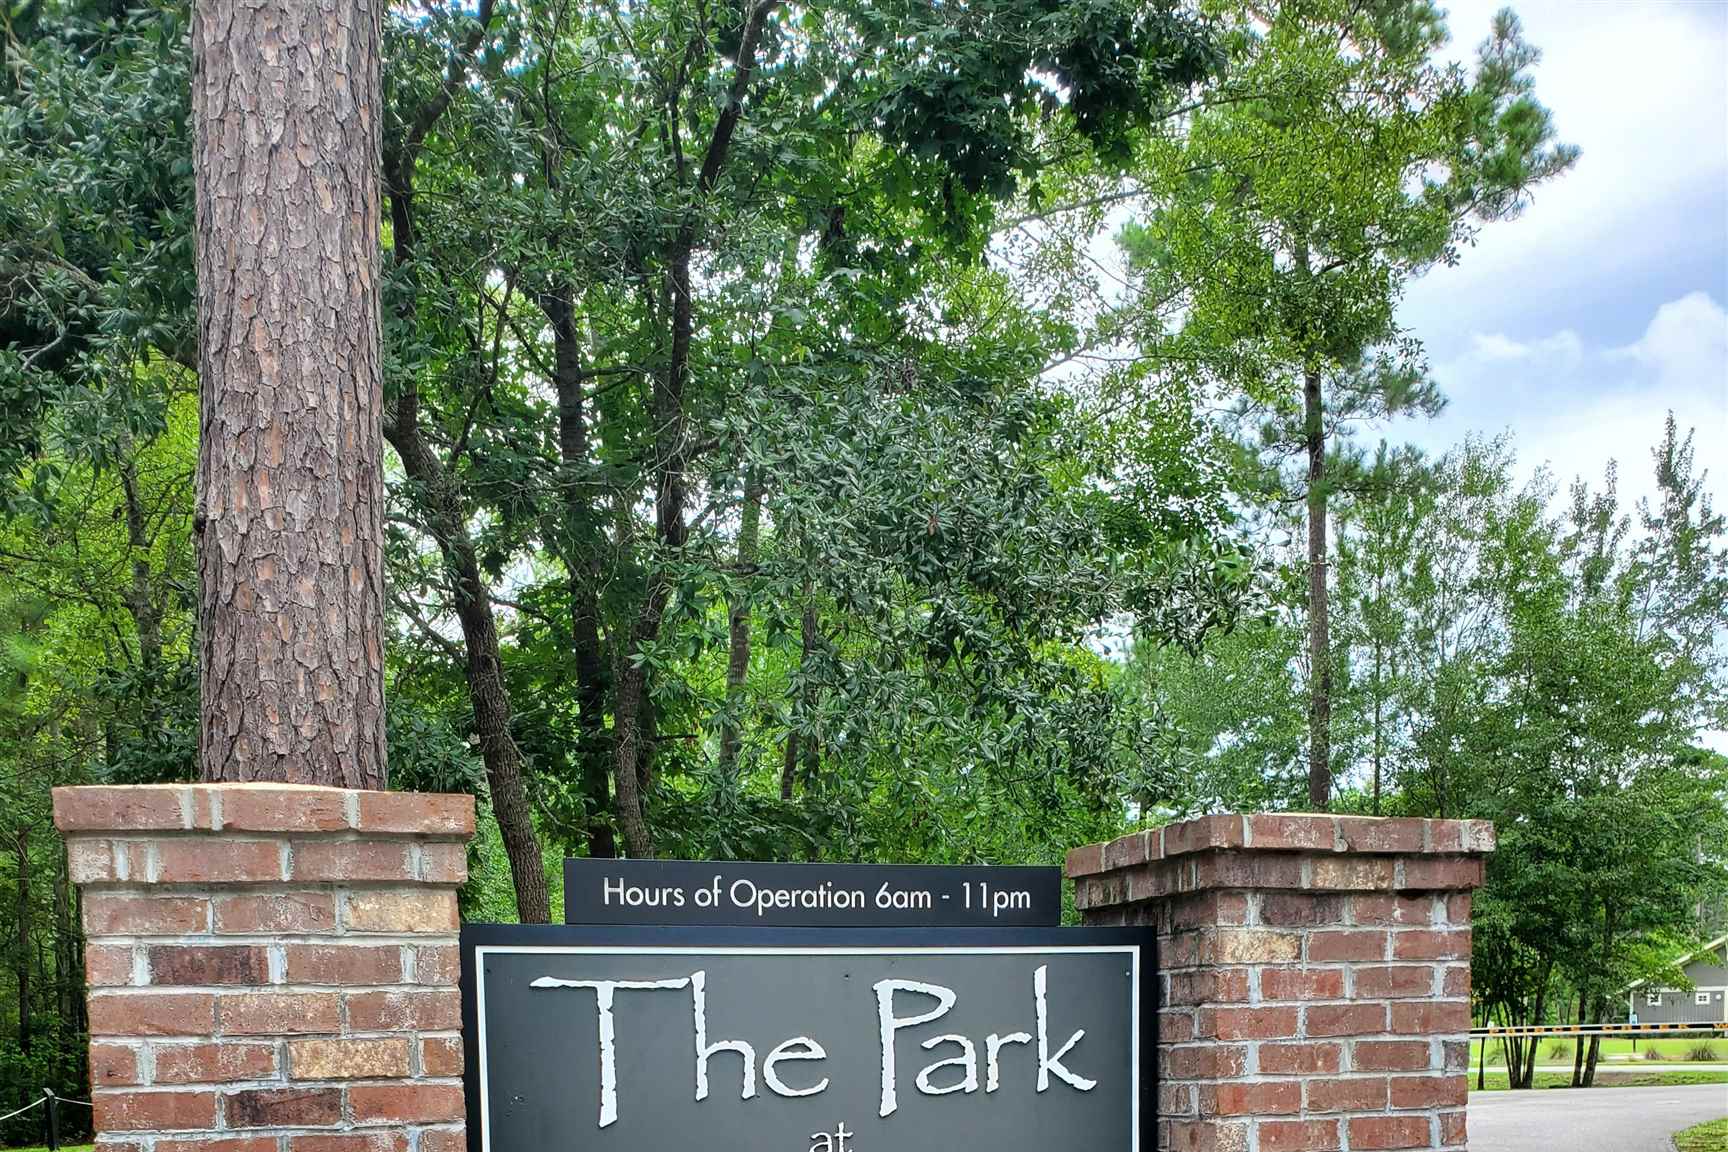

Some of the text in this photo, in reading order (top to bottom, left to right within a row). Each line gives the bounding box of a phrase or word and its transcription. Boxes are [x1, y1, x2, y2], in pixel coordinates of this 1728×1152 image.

[603, 877, 686, 907] Hours
[694, 875, 722, 907] of
[729, 879, 865, 917] Operation
[875, 881, 931, 909] 6am
[962, 882, 1031, 917] 11pm
[529, 965, 1097, 1128] The Park
